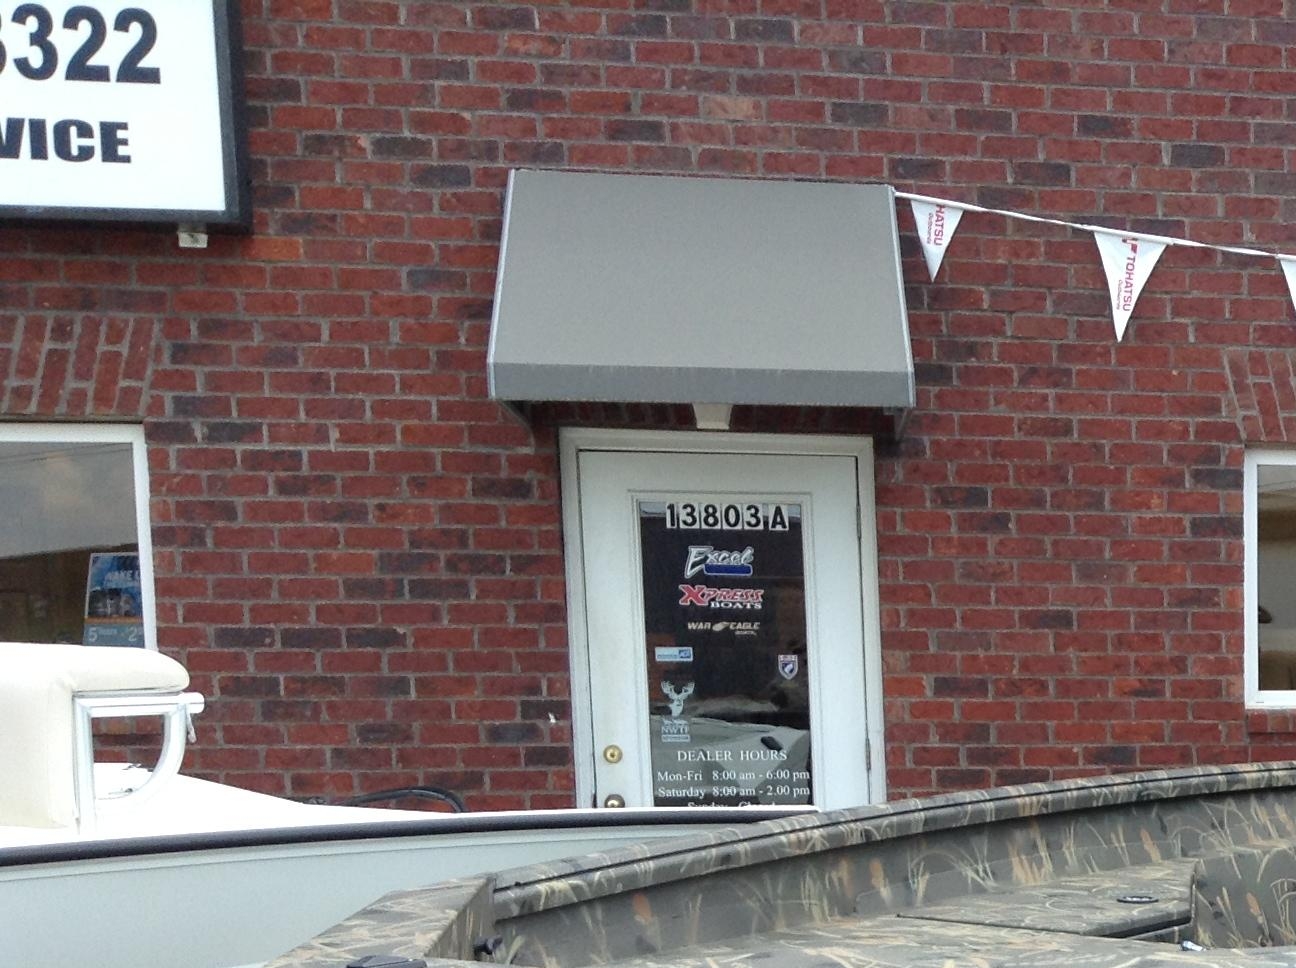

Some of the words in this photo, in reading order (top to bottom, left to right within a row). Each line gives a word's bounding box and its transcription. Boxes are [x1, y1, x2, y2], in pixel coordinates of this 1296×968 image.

[0, 2, 162, 84] 322
[1122, 255, 1136, 312] TOHATSU
[684, 545, 755, 579] Excel
[678, 584, 764, 606] XPRESS
[710, 601, 762, 609] BOATS
[687, 622, 711, 630] WAR
[677, 750, 732, 762] DEALER
[740, 750, 788, 761] HOURS
[657, 770, 703, 781] Mon-Fri
[712, 770, 736, 780] 8:00
[739, 772, 756, 780] am
[766, 770, 790, 780] 6:00
[792, 770, 810, 781] pm
[658, 786, 705, 799] Saturday
[712, 786, 736, 796] 8:00
[739, 788, 756, 796] am
[793, 786, 810, 797] pm
